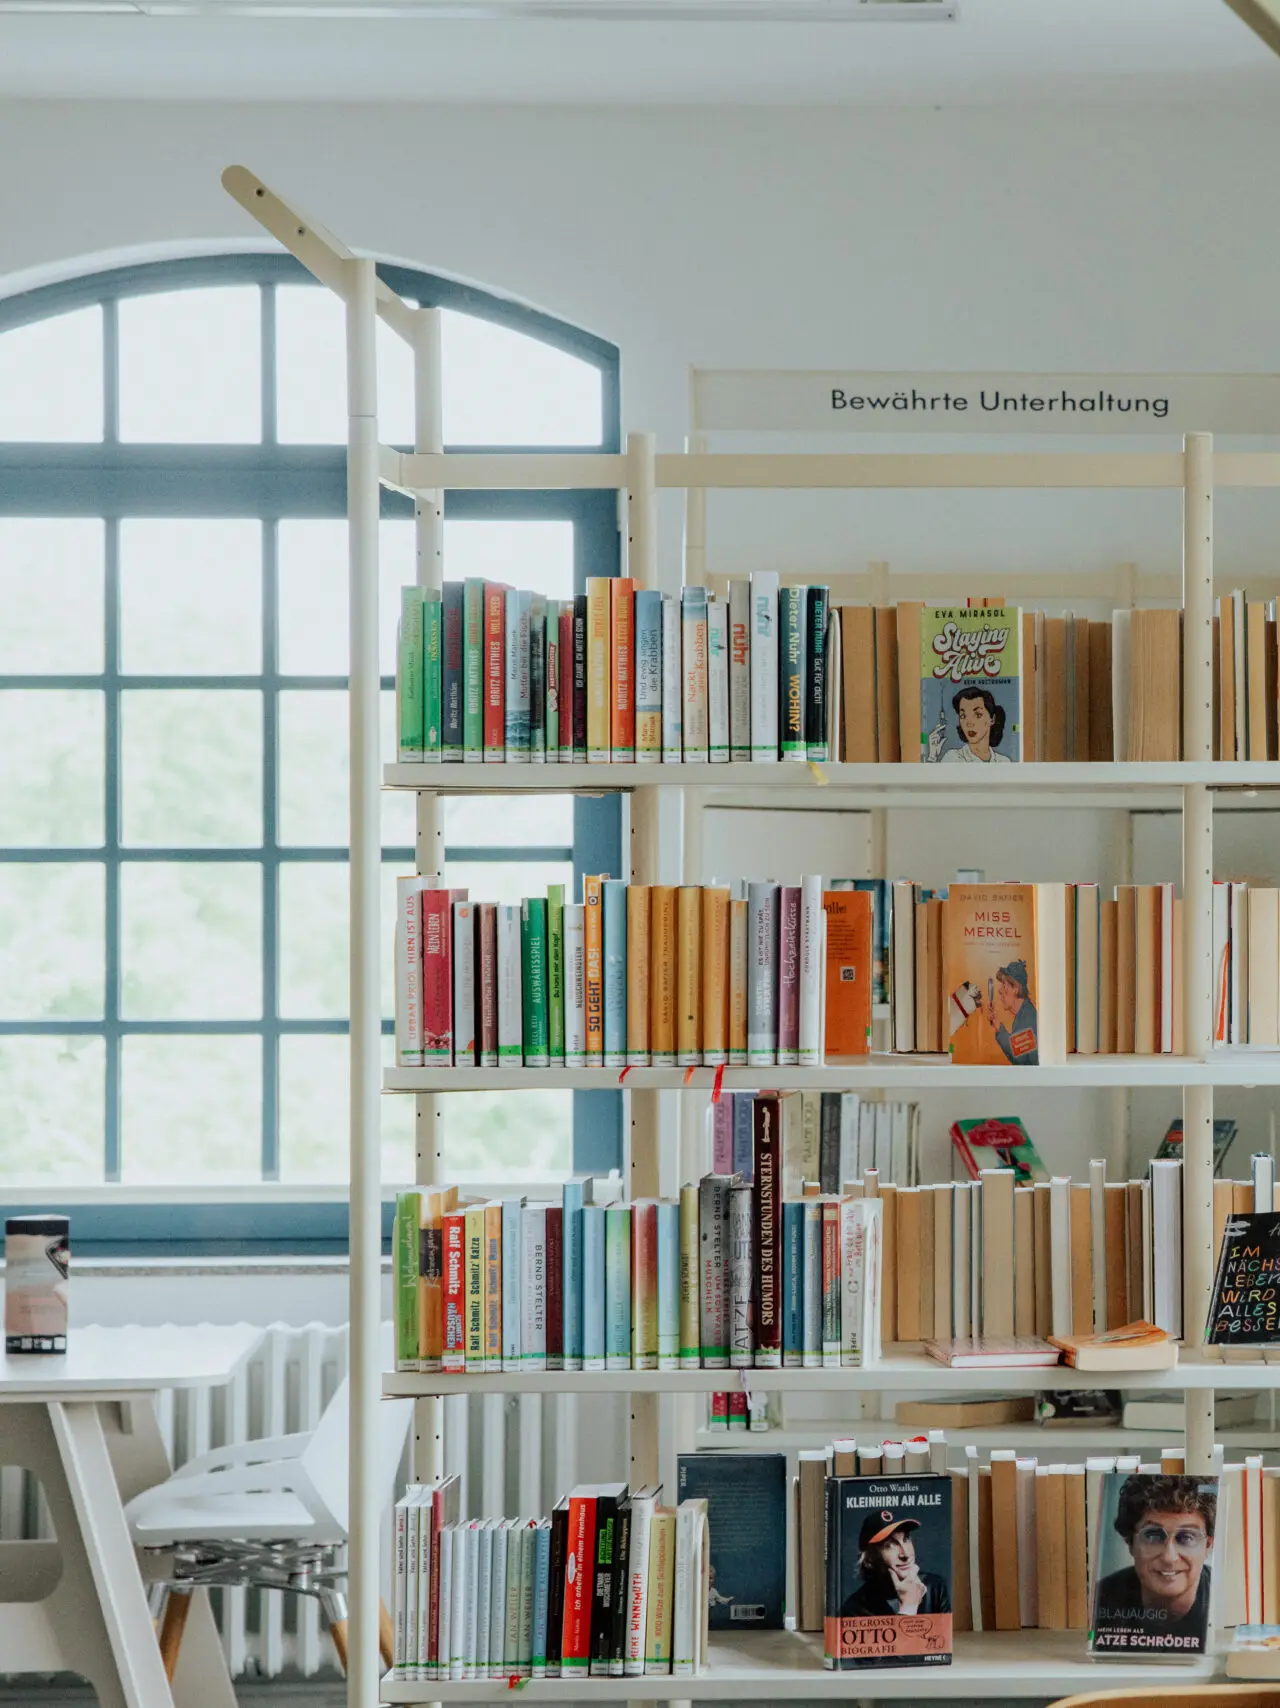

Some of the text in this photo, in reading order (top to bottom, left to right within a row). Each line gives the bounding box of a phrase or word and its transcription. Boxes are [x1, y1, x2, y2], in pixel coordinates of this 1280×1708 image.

[832, 390, 1169, 418] Bewährte Unterhaltung
[935, 609, 1005, 619] EVA MIRASOL
[694, 624, 704, 669] Krabben
[733, 623, 748, 666] nuhr
[814, 600, 822, 704] DIETER NUHR Gut für dich!
[932, 622, 1010, 658] Staying
[489, 641, 500, 677] MATTHIES
[639, 660, 649, 679] ewig
[648, 629, 658, 691] die Krabben
[788, 588, 800, 732] Dieter Nuhr WOHIN?
[933, 651, 1001, 683] Alive
[489, 680, 500, 706] MORITZ
[618, 684, 628, 710] MORITZ
[639, 681, 648, 700] Und
[688, 671, 696, 703] Nackt
[407, 895, 416, 916] AUS
[975, 911, 1011, 922] MISS
[407, 920, 416, 934] IST
[427, 913, 440, 933] LEBEN
[964, 927, 1022, 938] MERKEL
[407, 937, 416, 964] HIRN
[427, 934, 440, 954] MEIN
[784, 902, 797, 988] Hochzeitsküsse
[530, 936, 541, 1003] AUSWÄRTSSPIEL
[552, 990, 560, 998] Du
[588, 947, 600, 1032] SO GEHT DAS!
[470, 1238, 479, 1260] Katze
[760, 1152, 774, 1325] STERNSTUNDEN DES HUMORS
[448, 1226, 460, 1294] Ralf Schmitz
[1230, 1246, 1260, 1259] IM
[714, 1275, 721, 1288] UM
[470, 1301, 479, 1332] Schmitz
[1218, 1302, 1276, 1318] ALLES
[447, 1302, 456, 1348] HÄUSCHEN
[470, 1335, 479, 1350] Ralf
[869, 1483, 919, 1493] Otto Waalkes
[846, 1494, 941, 1509] KLEINHIRN AN ALLE
[577, 1504, 586, 1538] Irrenhaus
[524, 1586, 532, 1642] JAN WEILER
[631, 1573, 643, 1631] WINNEMUTH
[841, 1617, 895, 1628] DIE GROSSE
[841, 1629, 896, 1645] OTTO
[1096, 1634, 1199, 1648] ATZE SCHRÖDER
[841, 1646, 896, 1655] BIOGRAFIE
